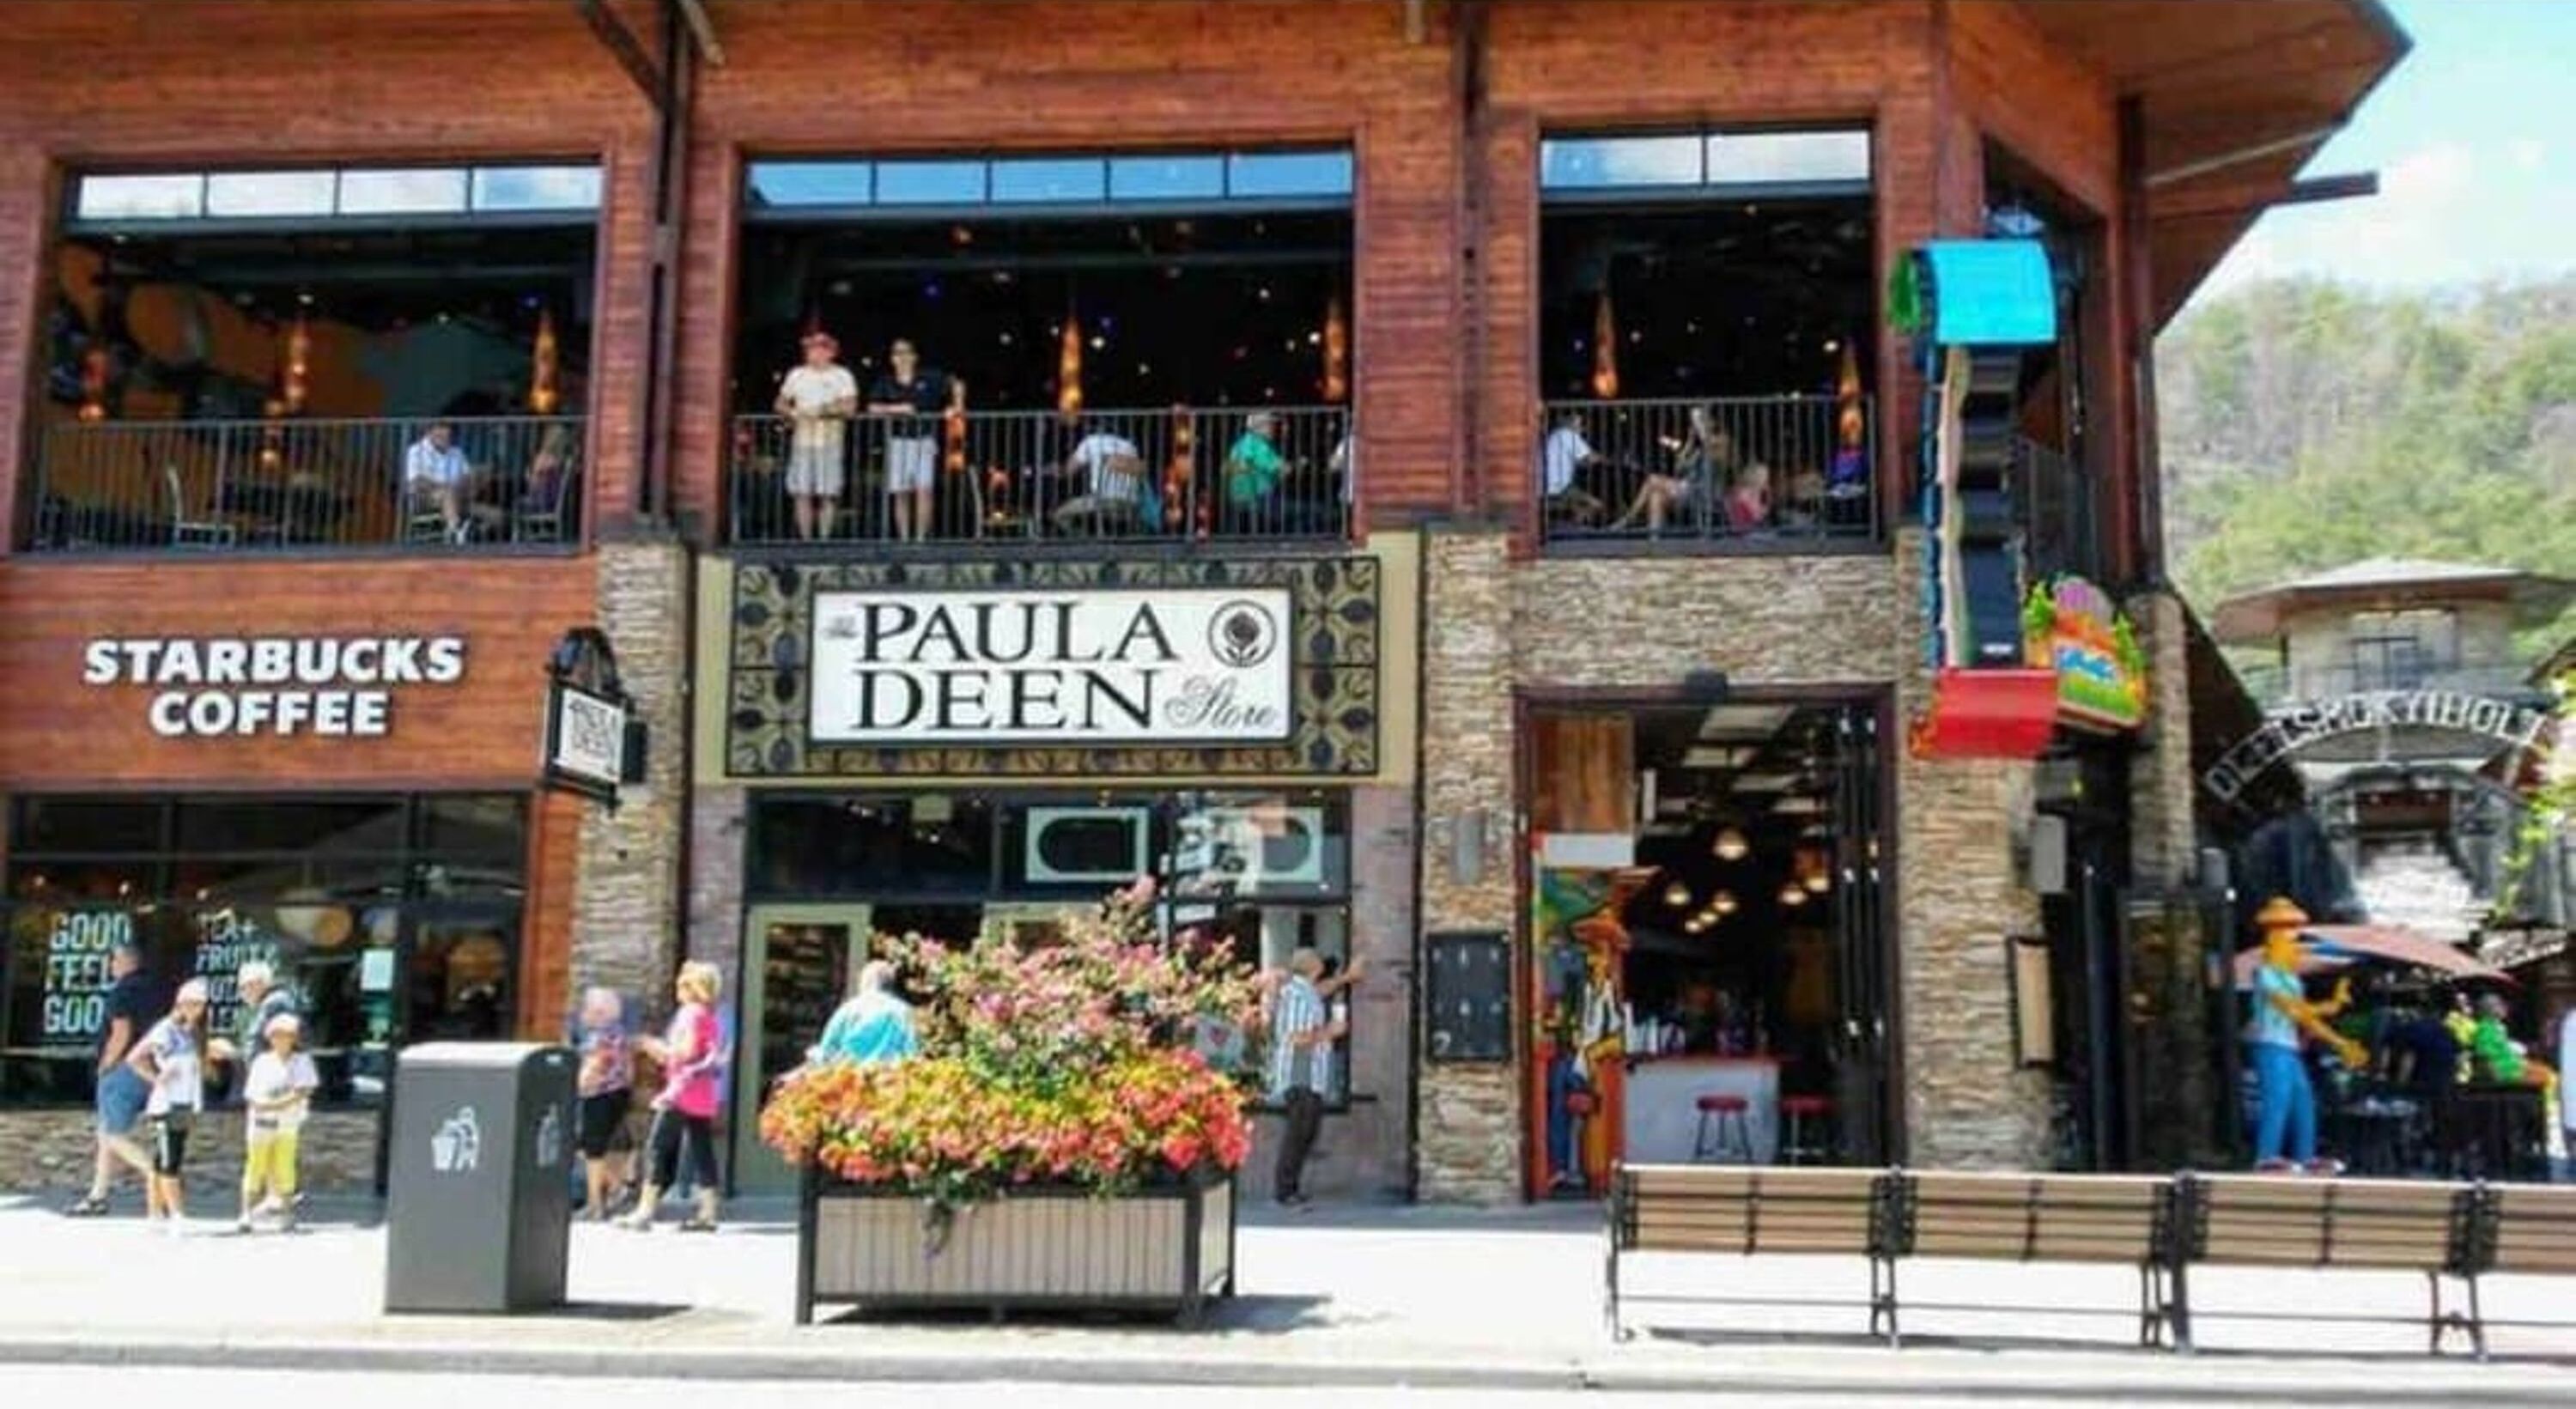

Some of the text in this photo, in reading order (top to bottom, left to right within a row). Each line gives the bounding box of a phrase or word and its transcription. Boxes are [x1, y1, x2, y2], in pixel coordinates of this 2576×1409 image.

[856, 600, 1180, 664] PAULA
[84, 638, 463, 684] STARBUCKS
[149, 690, 389, 736] COFFEE
[850, 668, 1278, 730] DEEN Store
[50, 912, 132, 949] GOOD
[46, 953, 118, 992] FEEL
[44, 994, 105, 1034] GOO
